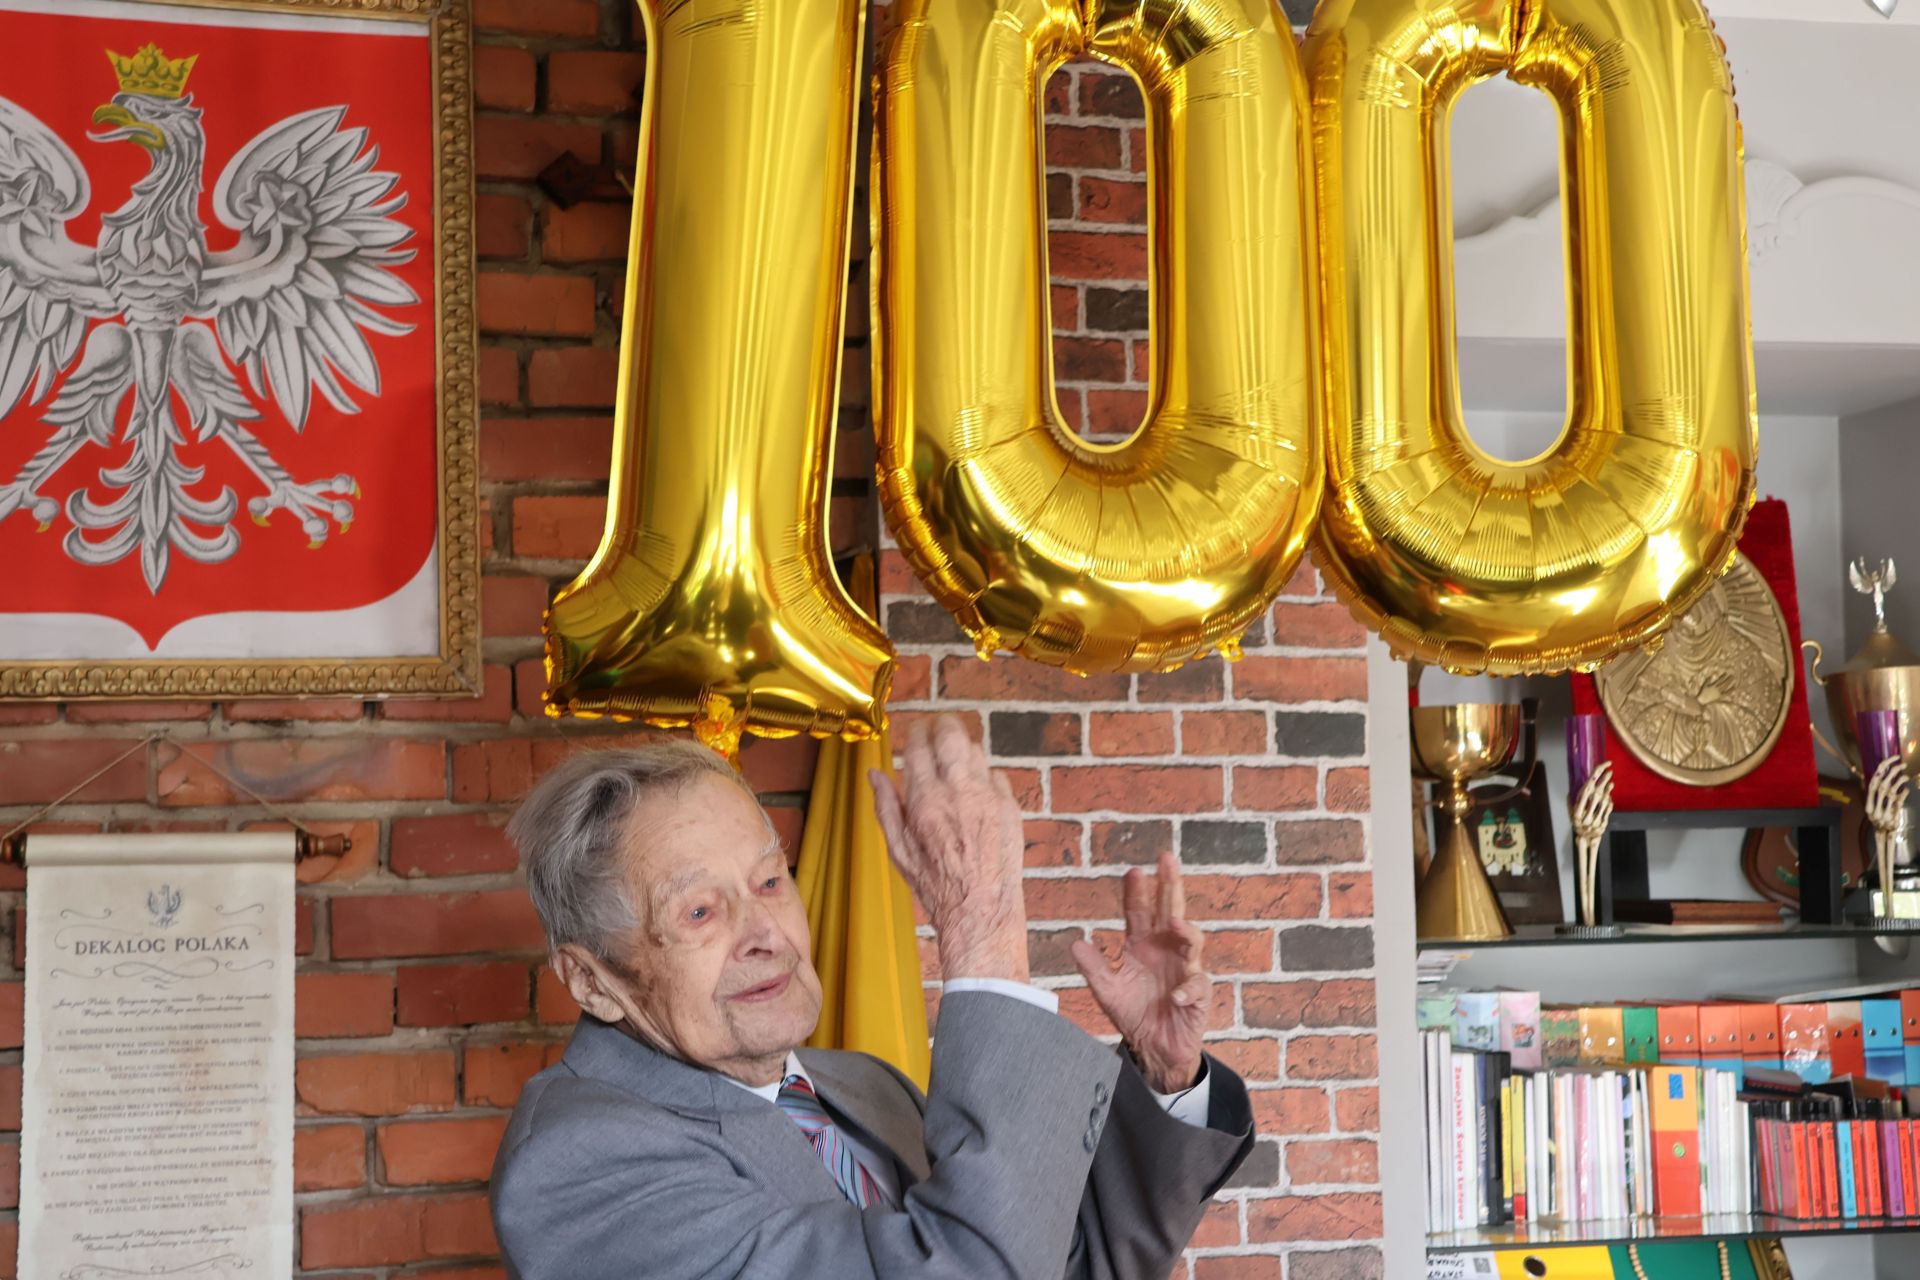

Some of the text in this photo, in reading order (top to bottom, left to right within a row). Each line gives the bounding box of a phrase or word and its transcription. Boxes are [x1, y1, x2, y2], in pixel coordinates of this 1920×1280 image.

[543, 0, 1758, 742] 100
[75, 936, 250, 955] DEKALOG POLAKA
